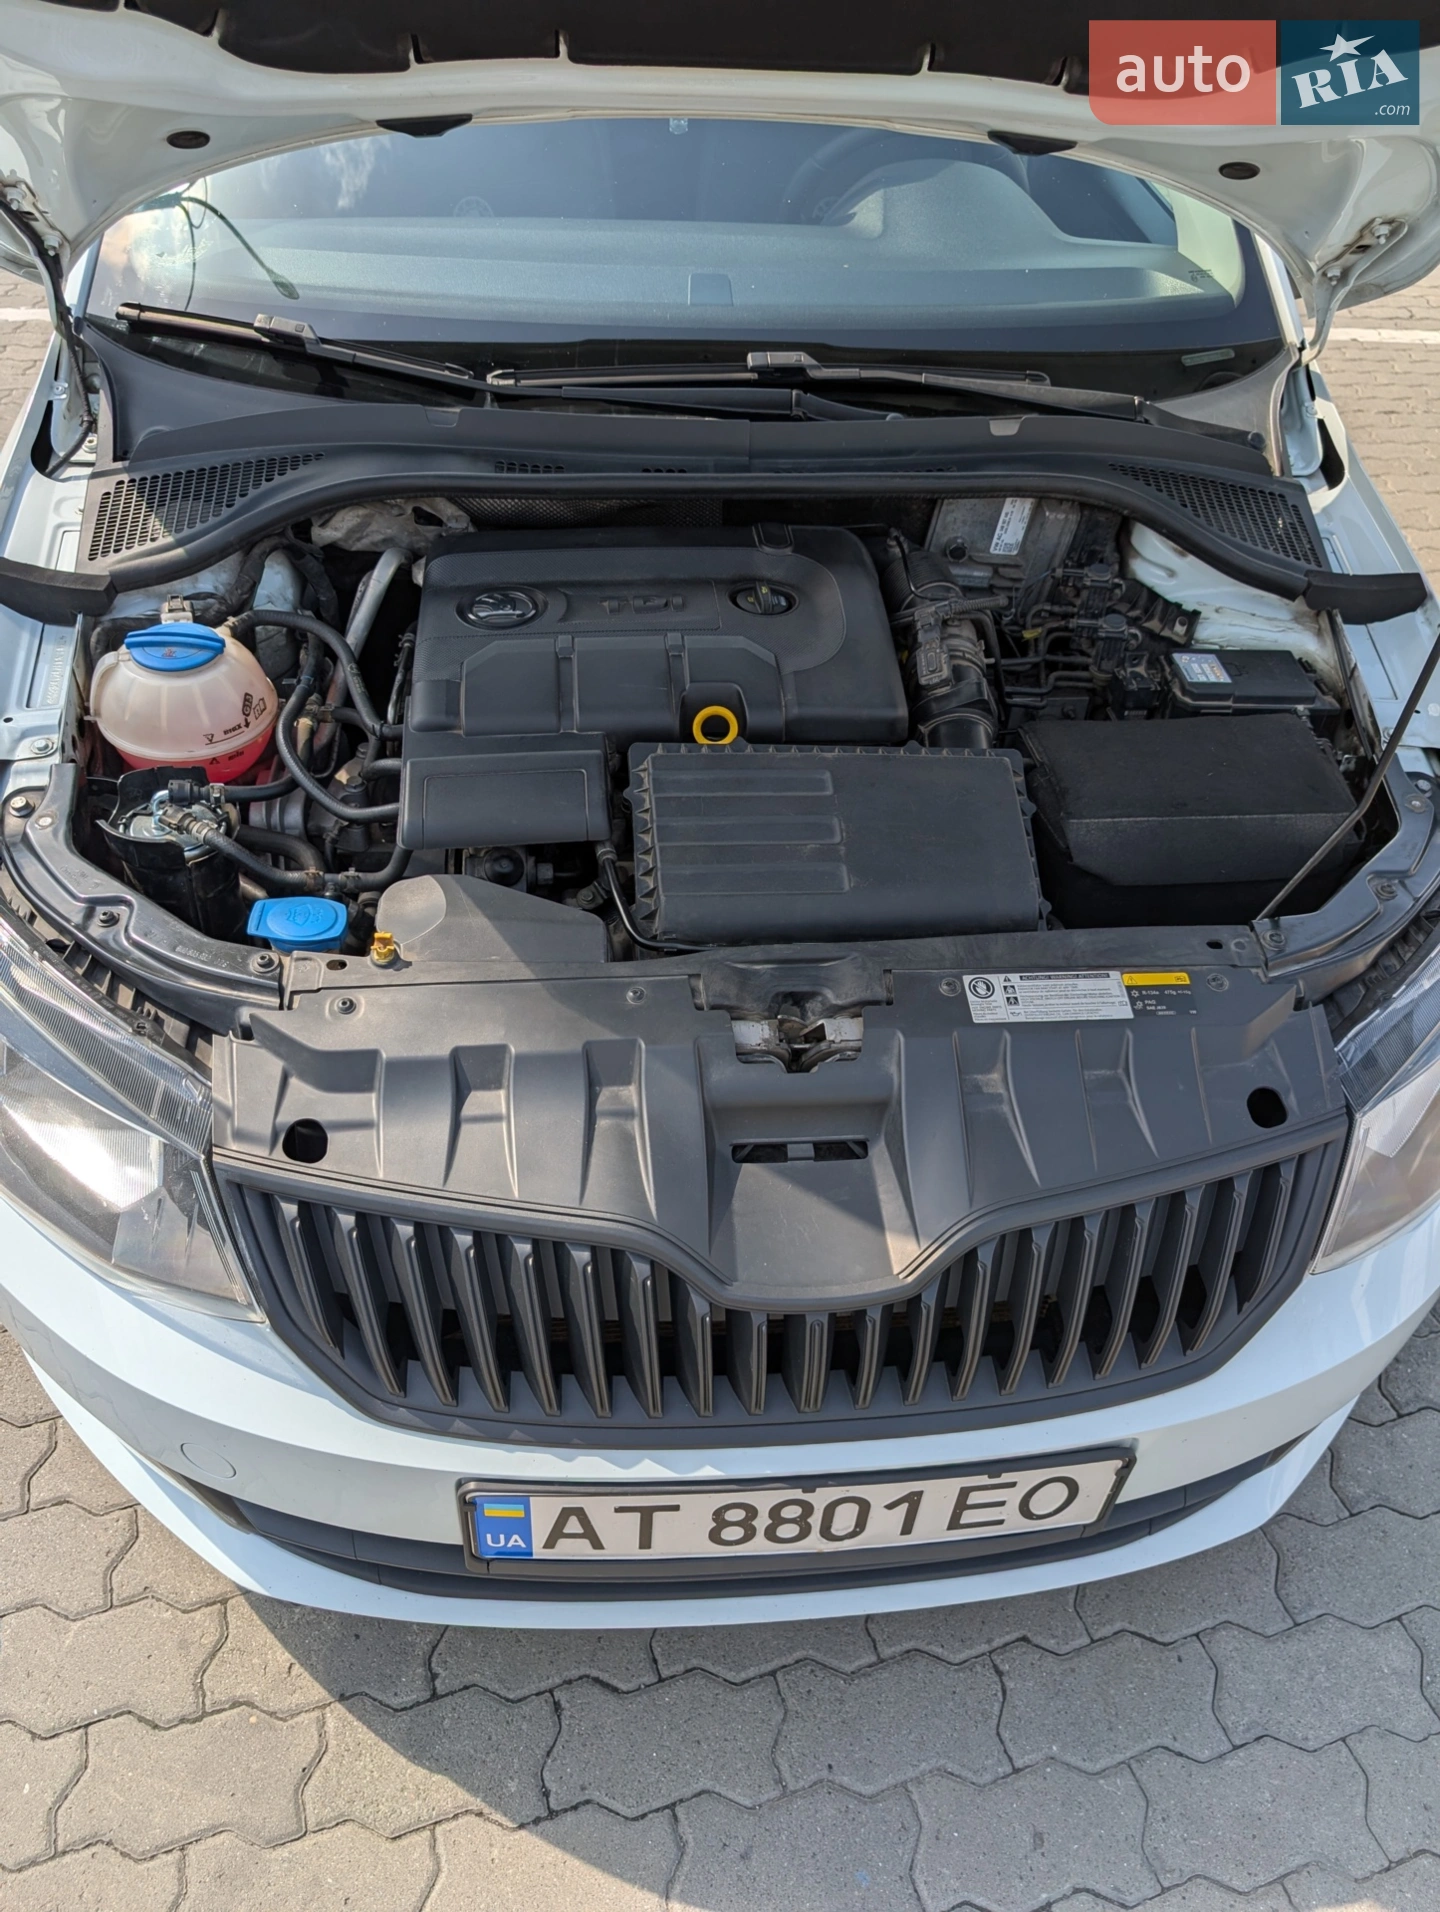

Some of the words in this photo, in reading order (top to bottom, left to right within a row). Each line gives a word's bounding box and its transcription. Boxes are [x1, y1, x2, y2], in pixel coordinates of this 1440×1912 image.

[542, 1504, 681, 1550] AT
[707, 1490, 925, 1547] 8801
[946, 1475, 1079, 1532] EO
[486, 1533, 526, 1548] UA
